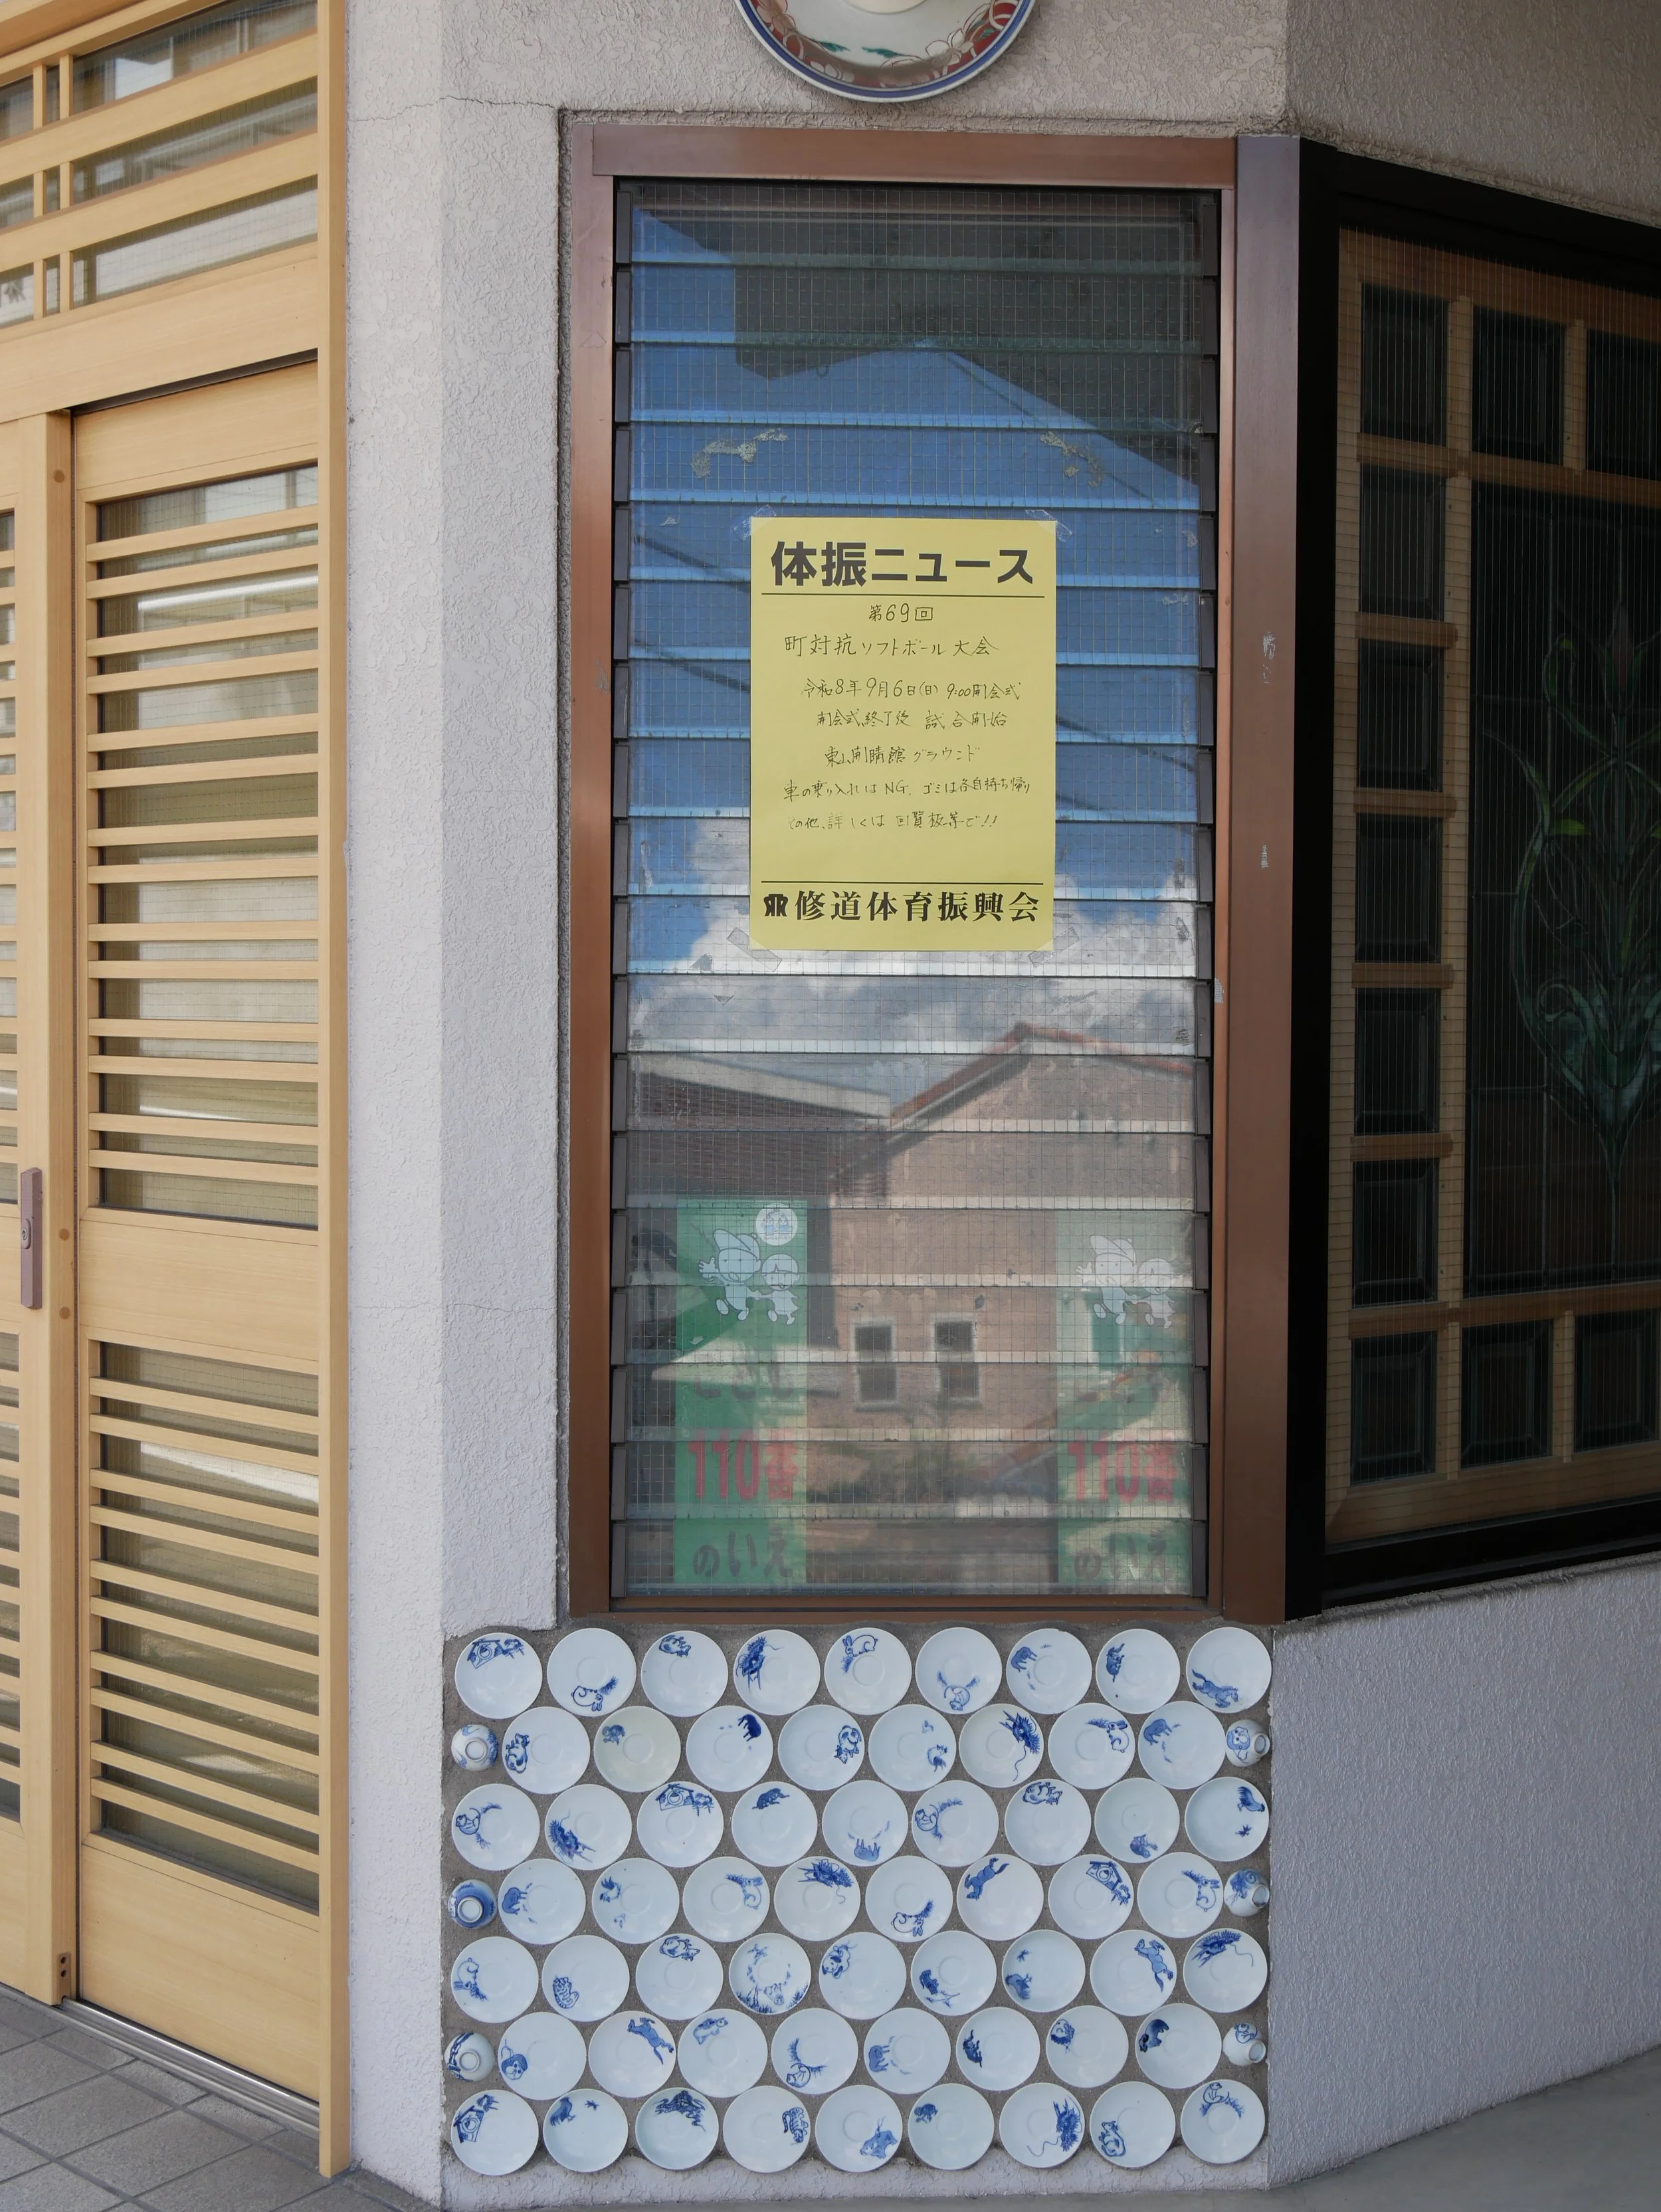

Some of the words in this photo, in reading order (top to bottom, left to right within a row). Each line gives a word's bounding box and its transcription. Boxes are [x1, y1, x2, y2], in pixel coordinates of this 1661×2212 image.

[770, 540, 1033, 587] 体振ニュース
[868, 603, 933, 623] 第69回
[794, 890, 1040, 922] 修道体育振興会
